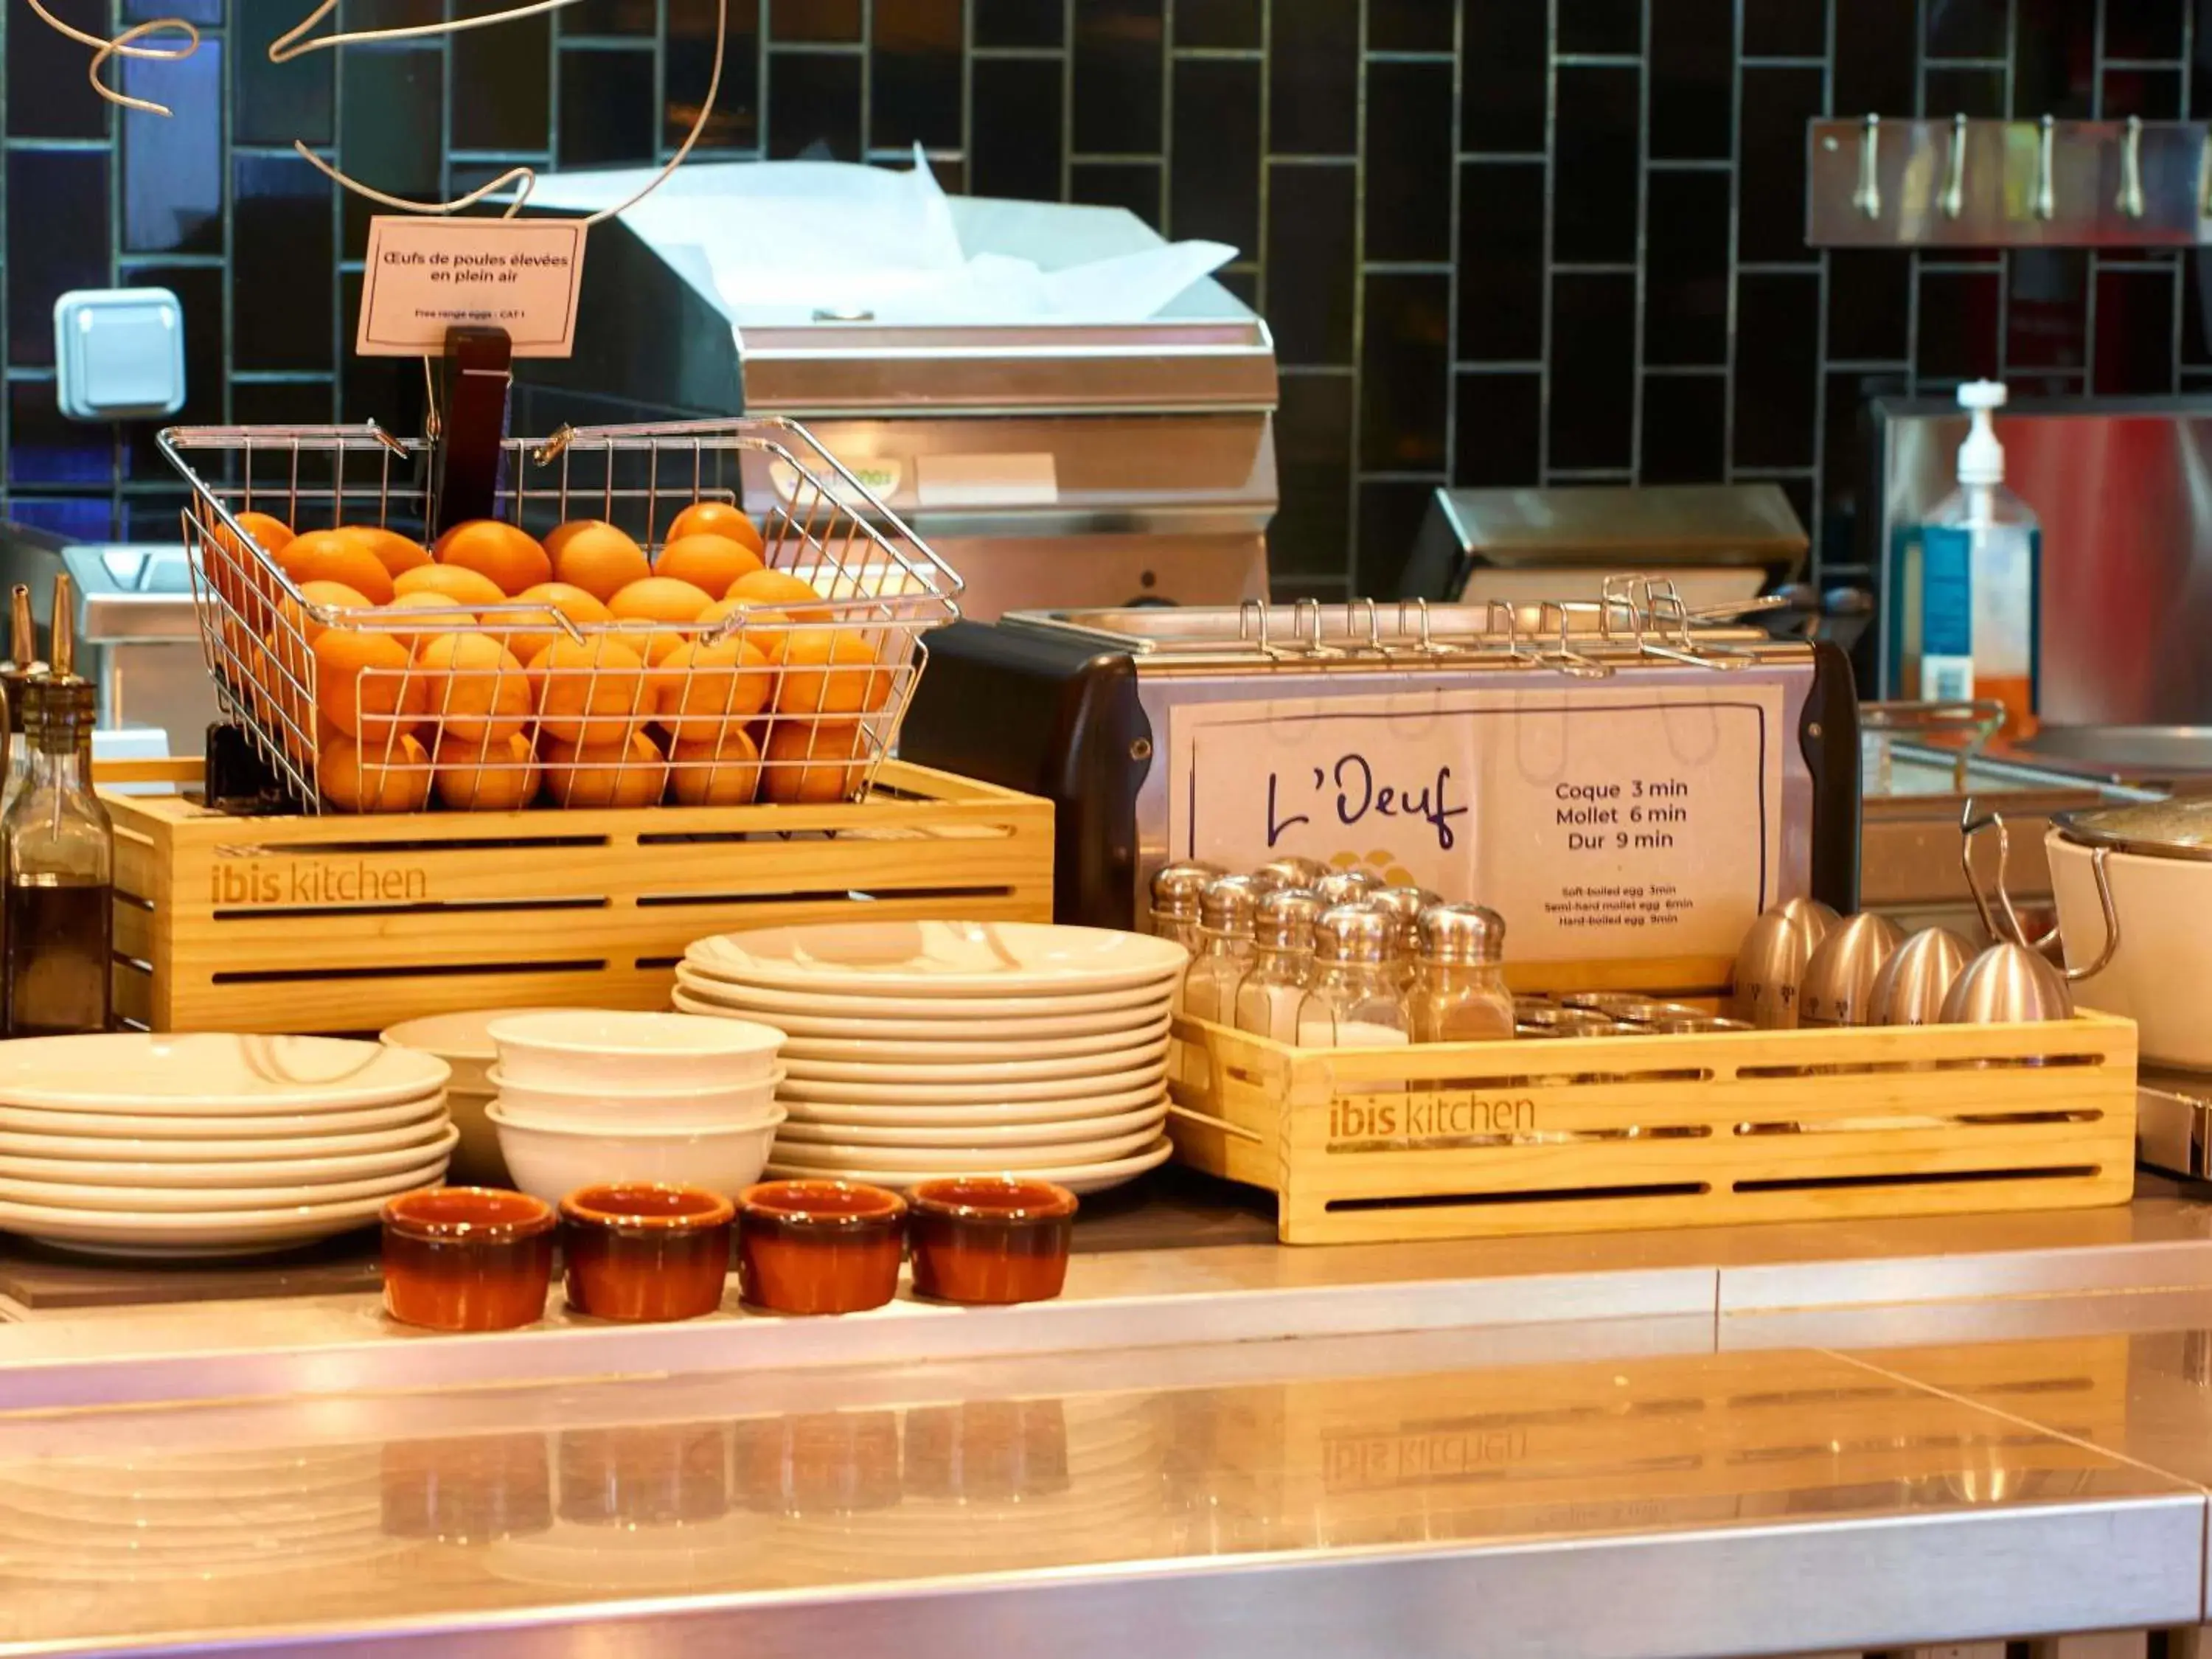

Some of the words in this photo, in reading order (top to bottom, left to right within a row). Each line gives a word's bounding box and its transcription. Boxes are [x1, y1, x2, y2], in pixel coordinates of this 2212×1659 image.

[383, 251, 425, 264] Œufs
[429, 251, 449, 263] de
[453, 251, 506, 266] poules
[509, 251, 568, 268] élevées
[431, 271, 451, 282] en
[454, 270, 494, 284] plein
[498, 270, 518, 283] air
[414, 308, 437, 319] Free
[438, 310, 466, 320] range
[468, 310, 492, 321] eggs
[499, 309, 517, 319] CAT
[1555, 782, 1621, 802] Coque
[1632, 779, 1643, 798] 3
[1649, 778, 1688, 797] min
[1556, 806, 1618, 825] Mollet
[1630, 805, 1642, 823] 6
[1648, 803, 1687, 823] min
[1568, 832, 1605, 850] Dur
[1616, 832, 1628, 849] 9
[1635, 829, 1674, 848] min
[211, 863, 282, 904] ibis
[291, 860, 427, 902] kitchen
[1623, 886, 1644, 898] egg
[1638, 901, 1660, 913] egg
[1624, 916, 1645, 927] egg
[1329, 1096, 1397, 1138] ibis
[1405, 1091, 1535, 1134] kitchen
